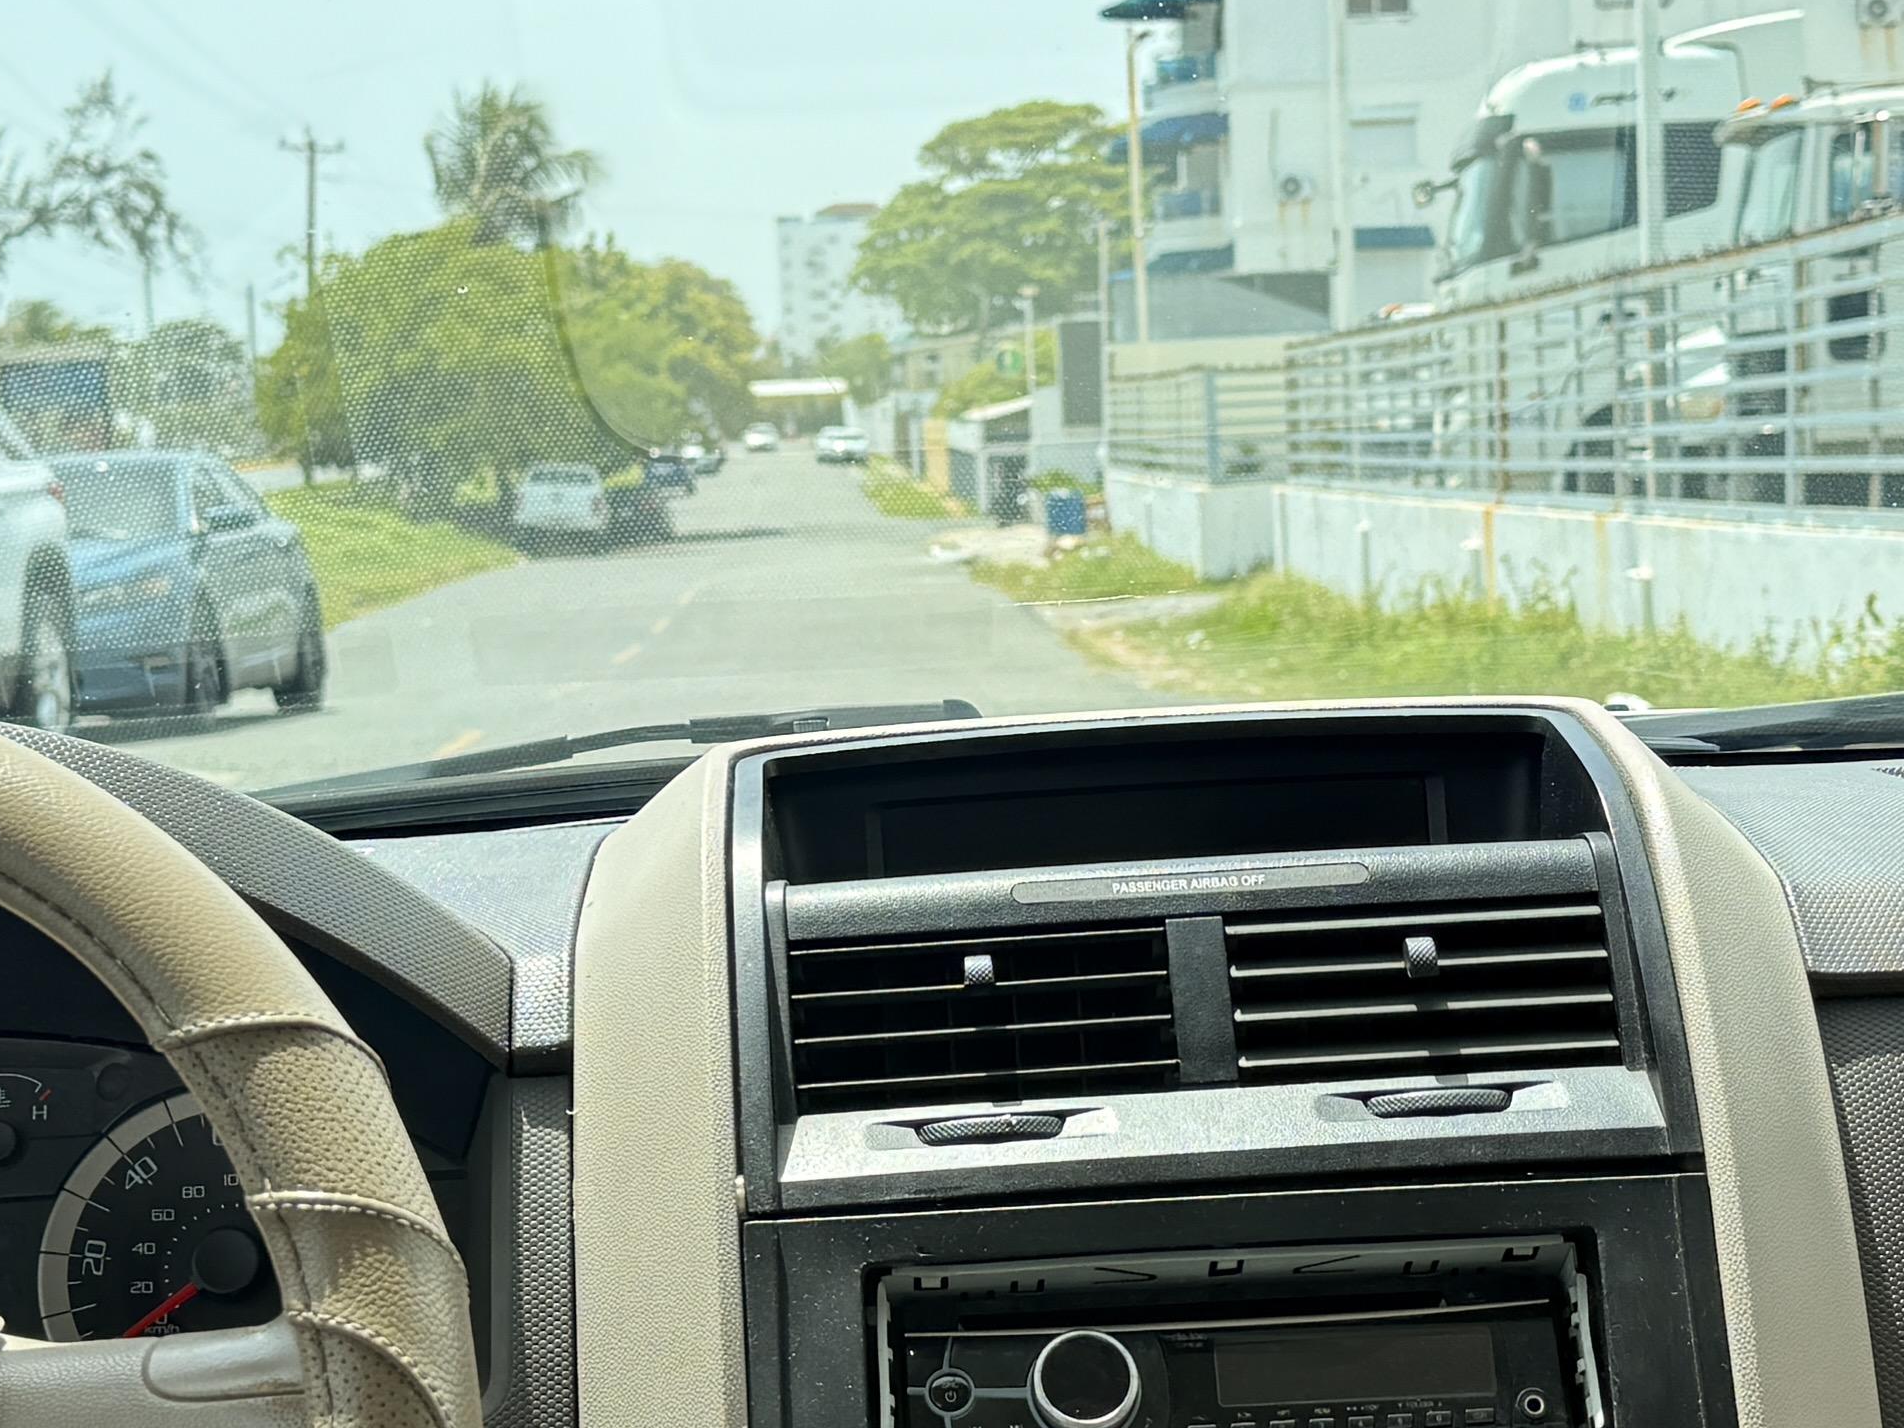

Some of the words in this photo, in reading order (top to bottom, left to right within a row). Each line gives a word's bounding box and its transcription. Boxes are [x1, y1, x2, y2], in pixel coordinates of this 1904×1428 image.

[1111, 878, 1188, 894] PASSENGER
[1190, 875, 1239, 890] AIRBAG
[1241, 873, 1266, 887] OFF
[31, 1104, 48, 1121] H
[125, 1156, 159, 1190] 40
[181, 1185, 206, 1199] 80
[151, 1209, 176, 1222] 60
[132, 1242, 156, 1255] 40
[82, 1239, 108, 1276] 20
[129, 1281, 154, 1294] 20
